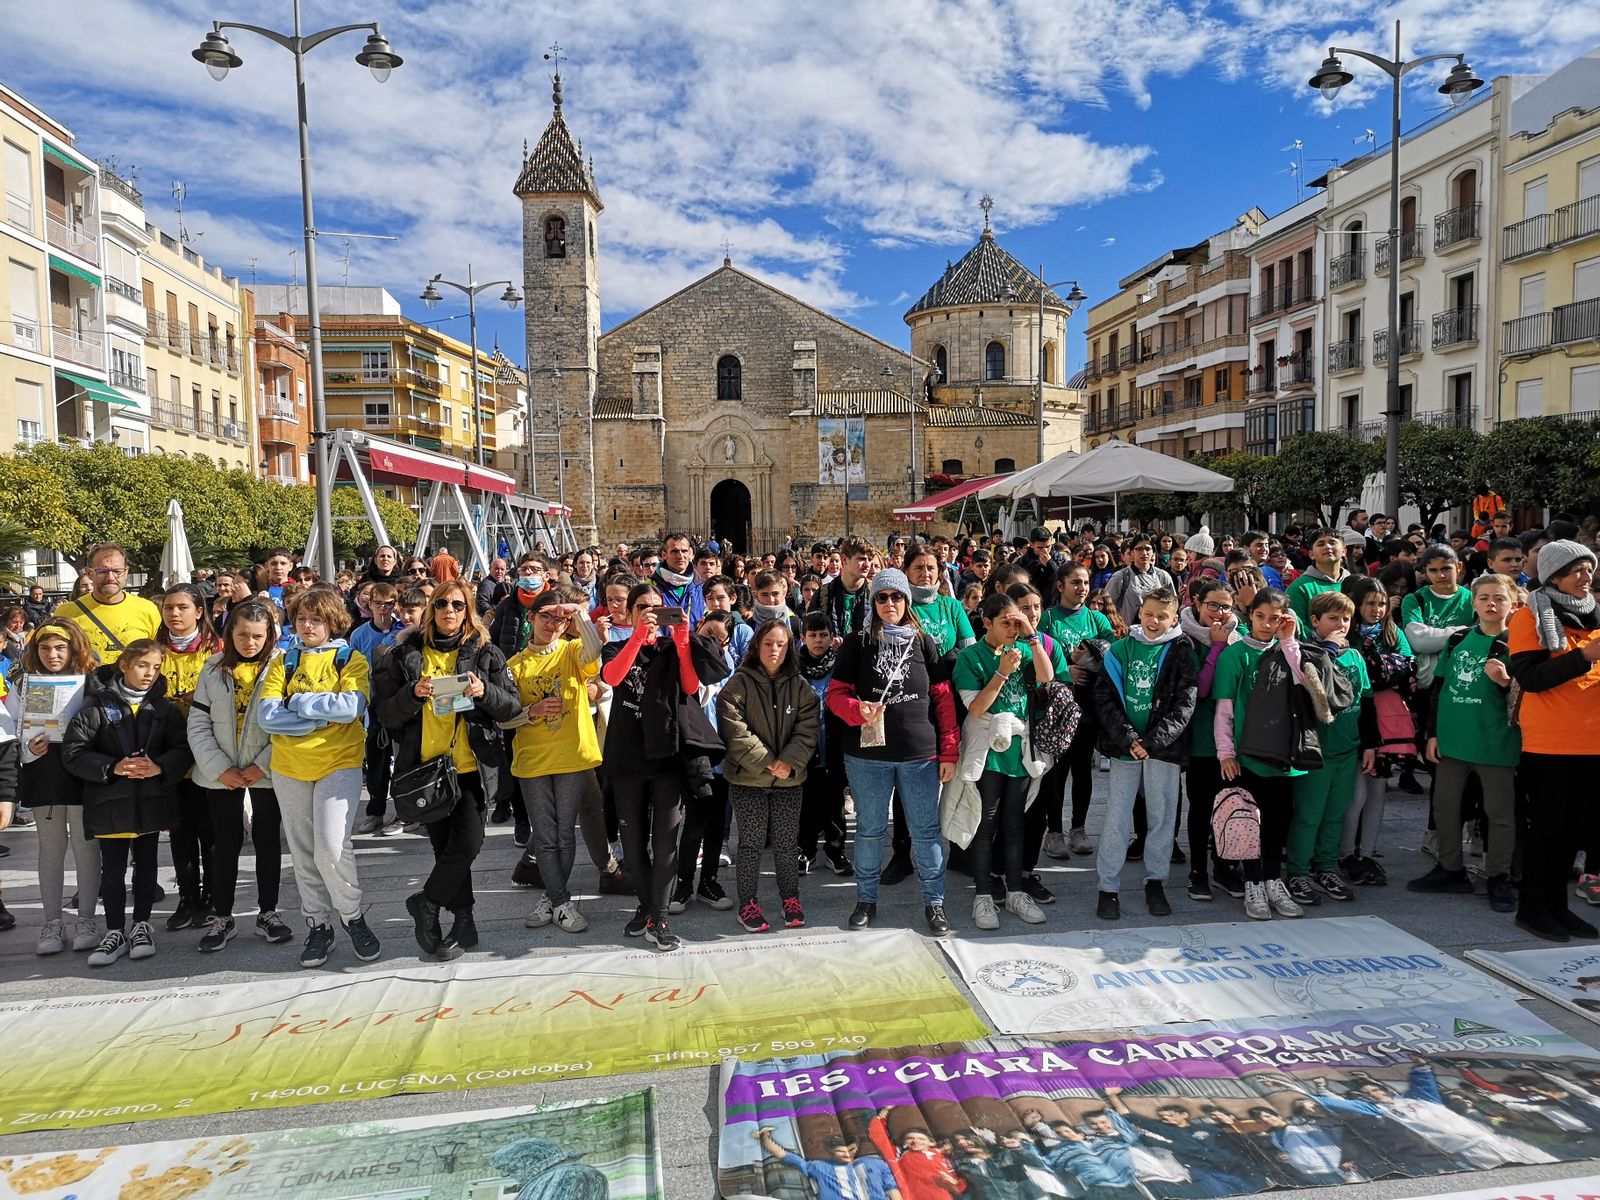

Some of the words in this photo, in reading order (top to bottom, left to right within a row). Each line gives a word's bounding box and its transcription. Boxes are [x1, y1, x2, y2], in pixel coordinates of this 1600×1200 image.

[1093, 964, 1255, 990] ANTONIO
[1256, 953, 1444, 978] MACHADO
[471, 995, 532, 1016] de
[174, 1098, 194, 1109] 2
[249, 1084, 330, 1101] 14900
[338, 1073, 457, 1094] LUCENA
[770, 1039, 815, 1051] 596
[821, 1035, 866, 1048] 740
[757, 1069, 851, 1097] IES
[279, 1161, 401, 1189] COMARES
